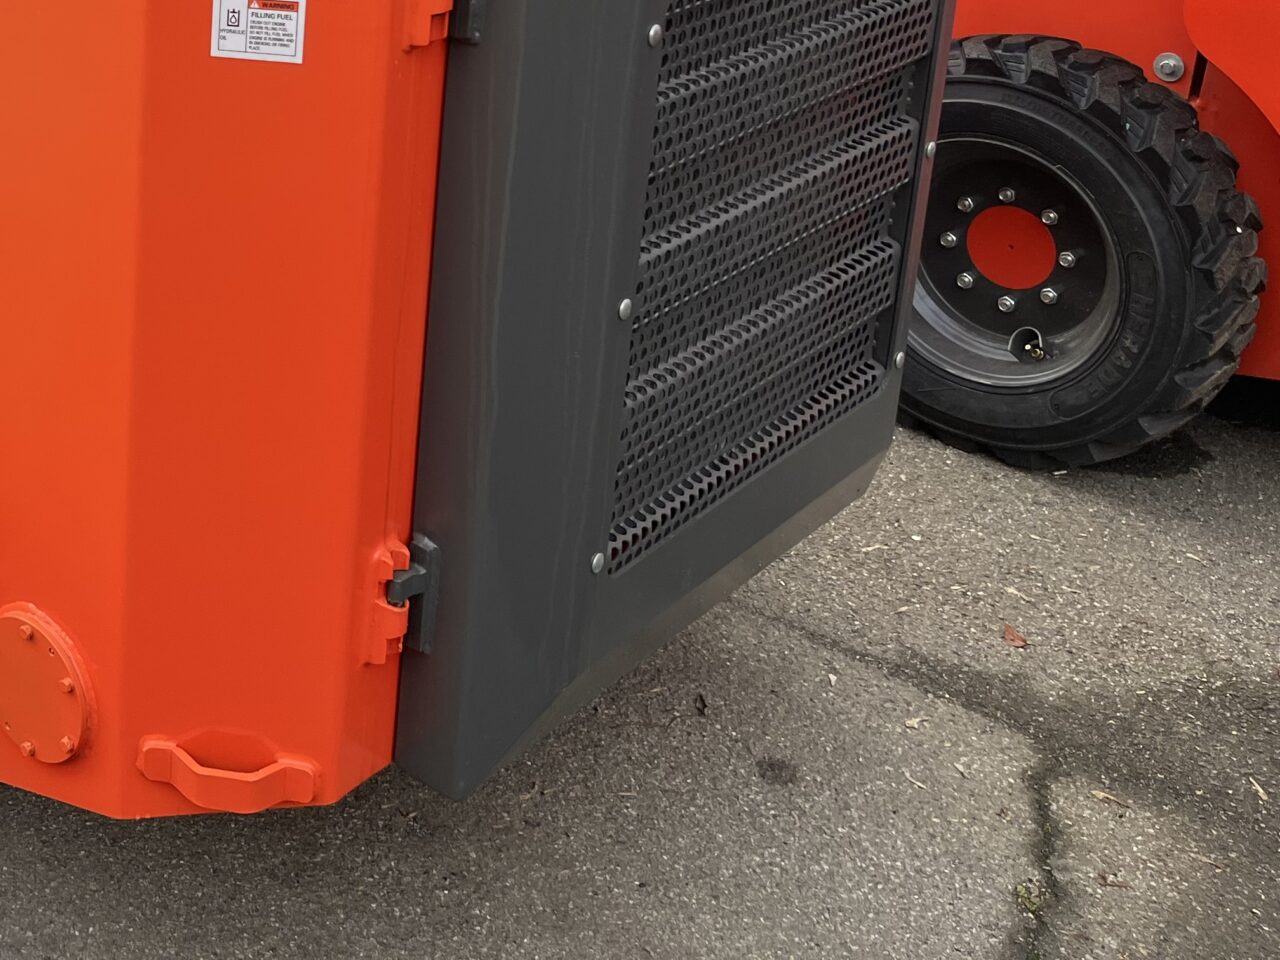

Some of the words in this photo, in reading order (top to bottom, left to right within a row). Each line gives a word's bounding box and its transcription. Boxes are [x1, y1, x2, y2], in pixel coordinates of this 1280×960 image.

[262, 2, 294, 10] WARNING
[251, 11, 276, 19] FILLING
[277, 13, 293, 21] FUEL
